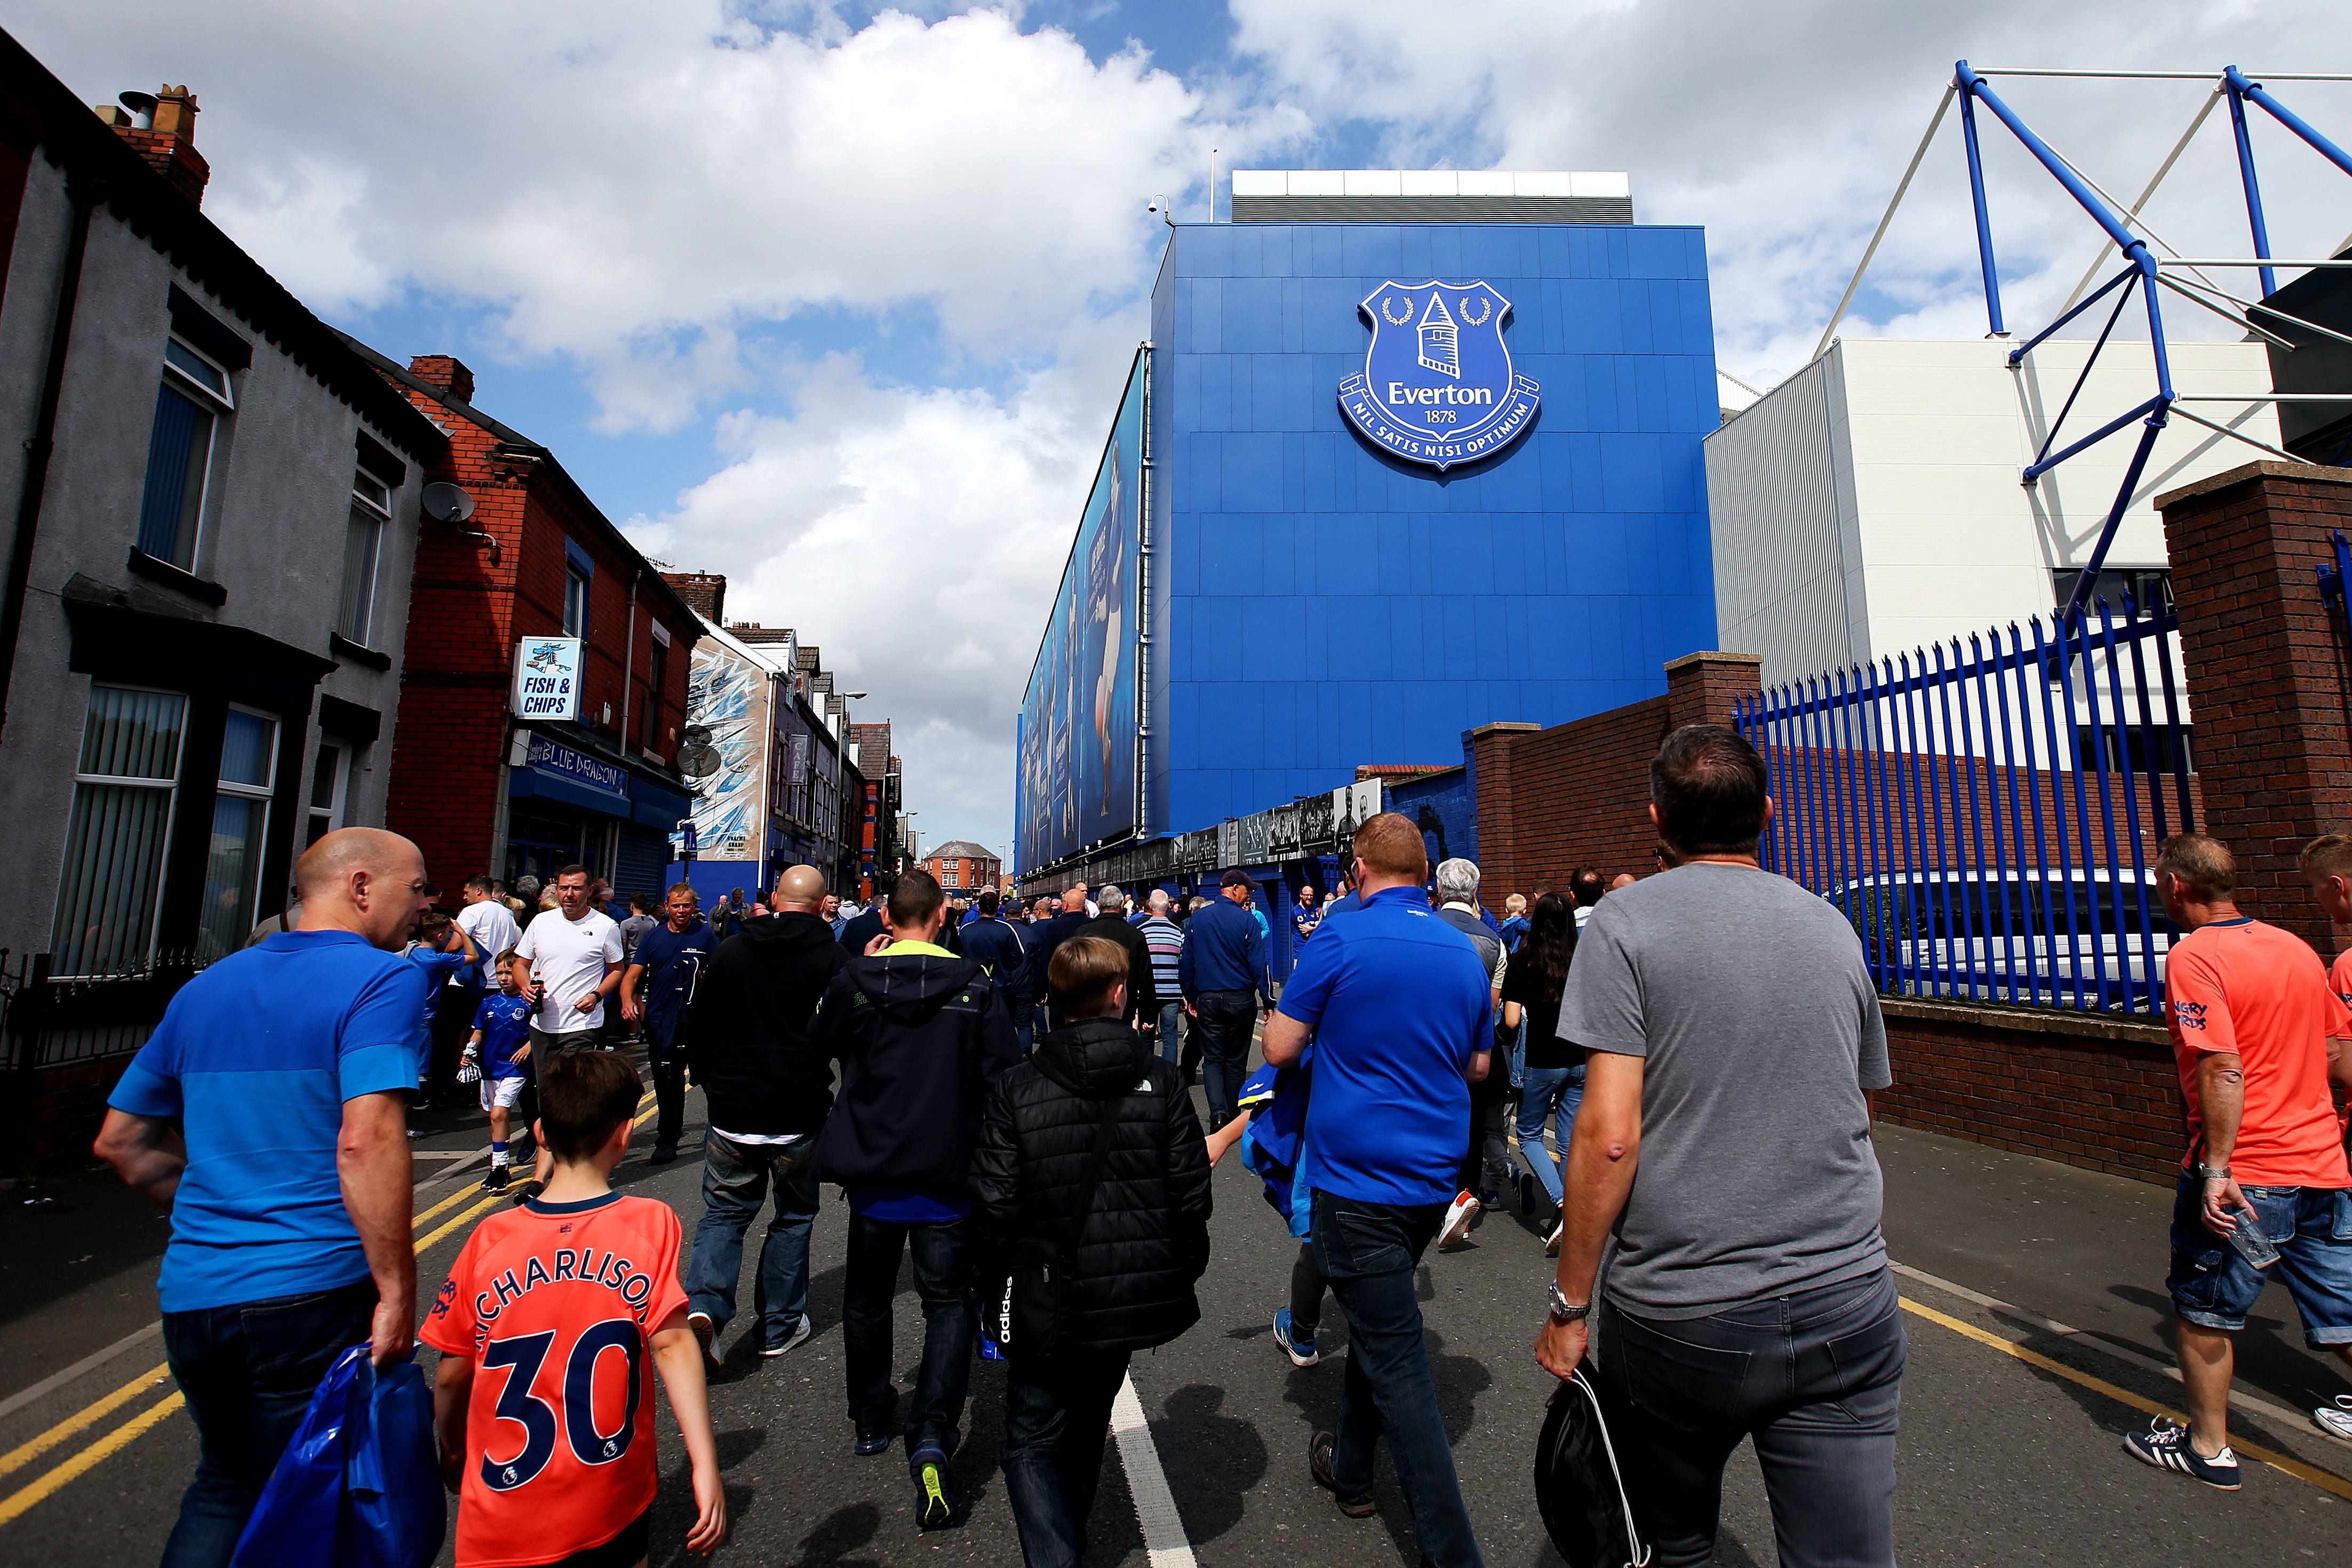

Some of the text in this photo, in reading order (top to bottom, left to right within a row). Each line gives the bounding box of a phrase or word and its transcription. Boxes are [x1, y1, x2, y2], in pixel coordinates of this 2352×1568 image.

[1388, 382, 1492, 405] Everton
[1352, 402, 1528, 457] NIL SATIS NISI OPTIMUM
[1424, 410, 1457, 423] 1878
[524, 677, 570, 694] FISH &
[524, 697, 566, 713] CHIPS
[542, 741, 575, 770] BLUE
[576, 755, 617, 786] DRAGON
[792, 742, 802, 779] CAFE
[1000, 1276, 1012, 1343] adidas
[481, 1318, 643, 1491] 30
